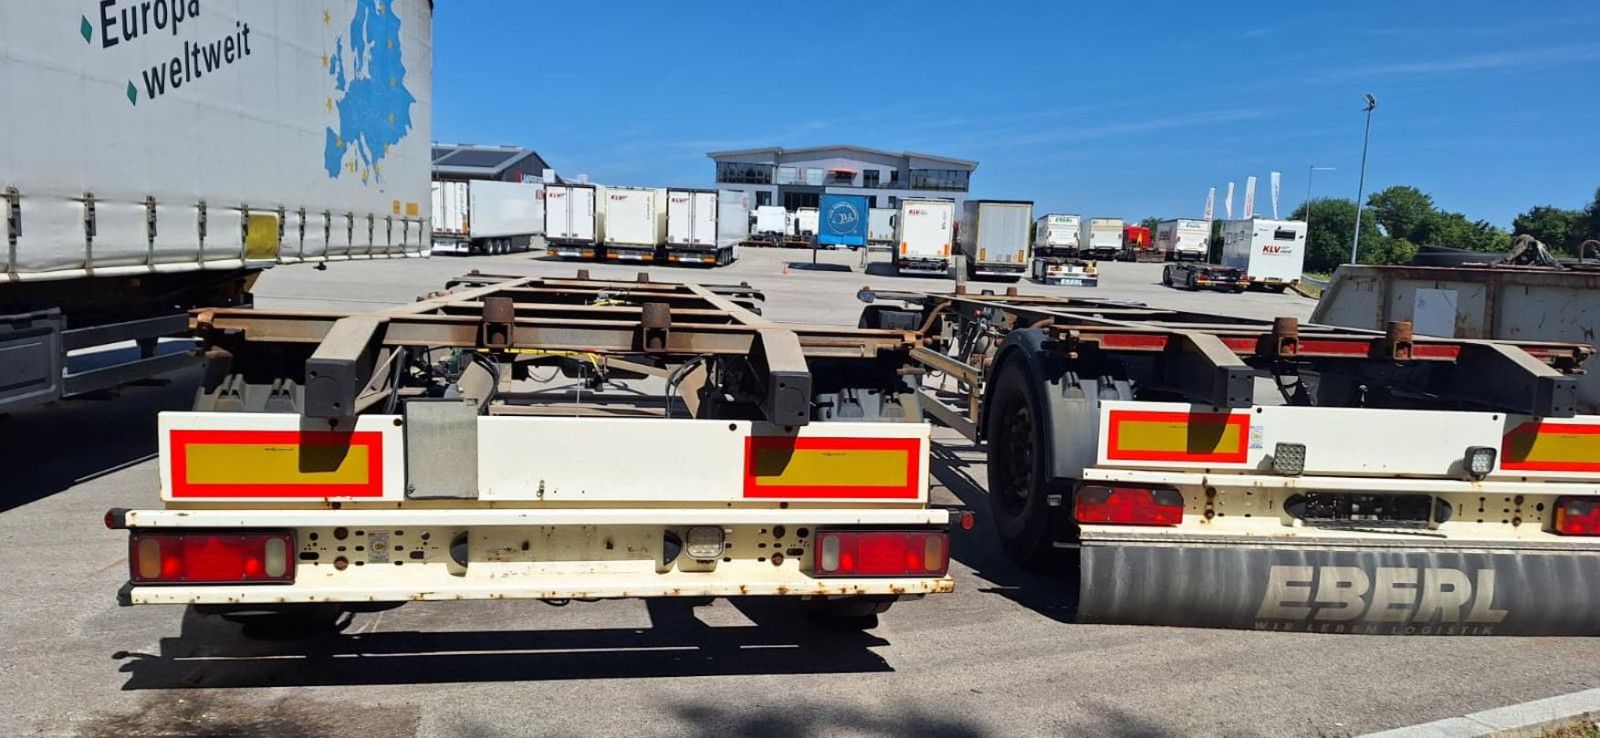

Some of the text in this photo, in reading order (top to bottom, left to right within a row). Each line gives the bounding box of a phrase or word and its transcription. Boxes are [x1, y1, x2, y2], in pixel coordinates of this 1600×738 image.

[100, 0, 200, 48] Europa
[142, 21, 251, 99] weltweit
[1262, 245, 1281, 253] KLV
[1256, 565, 1509, 622] EBERL
[1392, 625, 1495, 635] LOGISTIK
